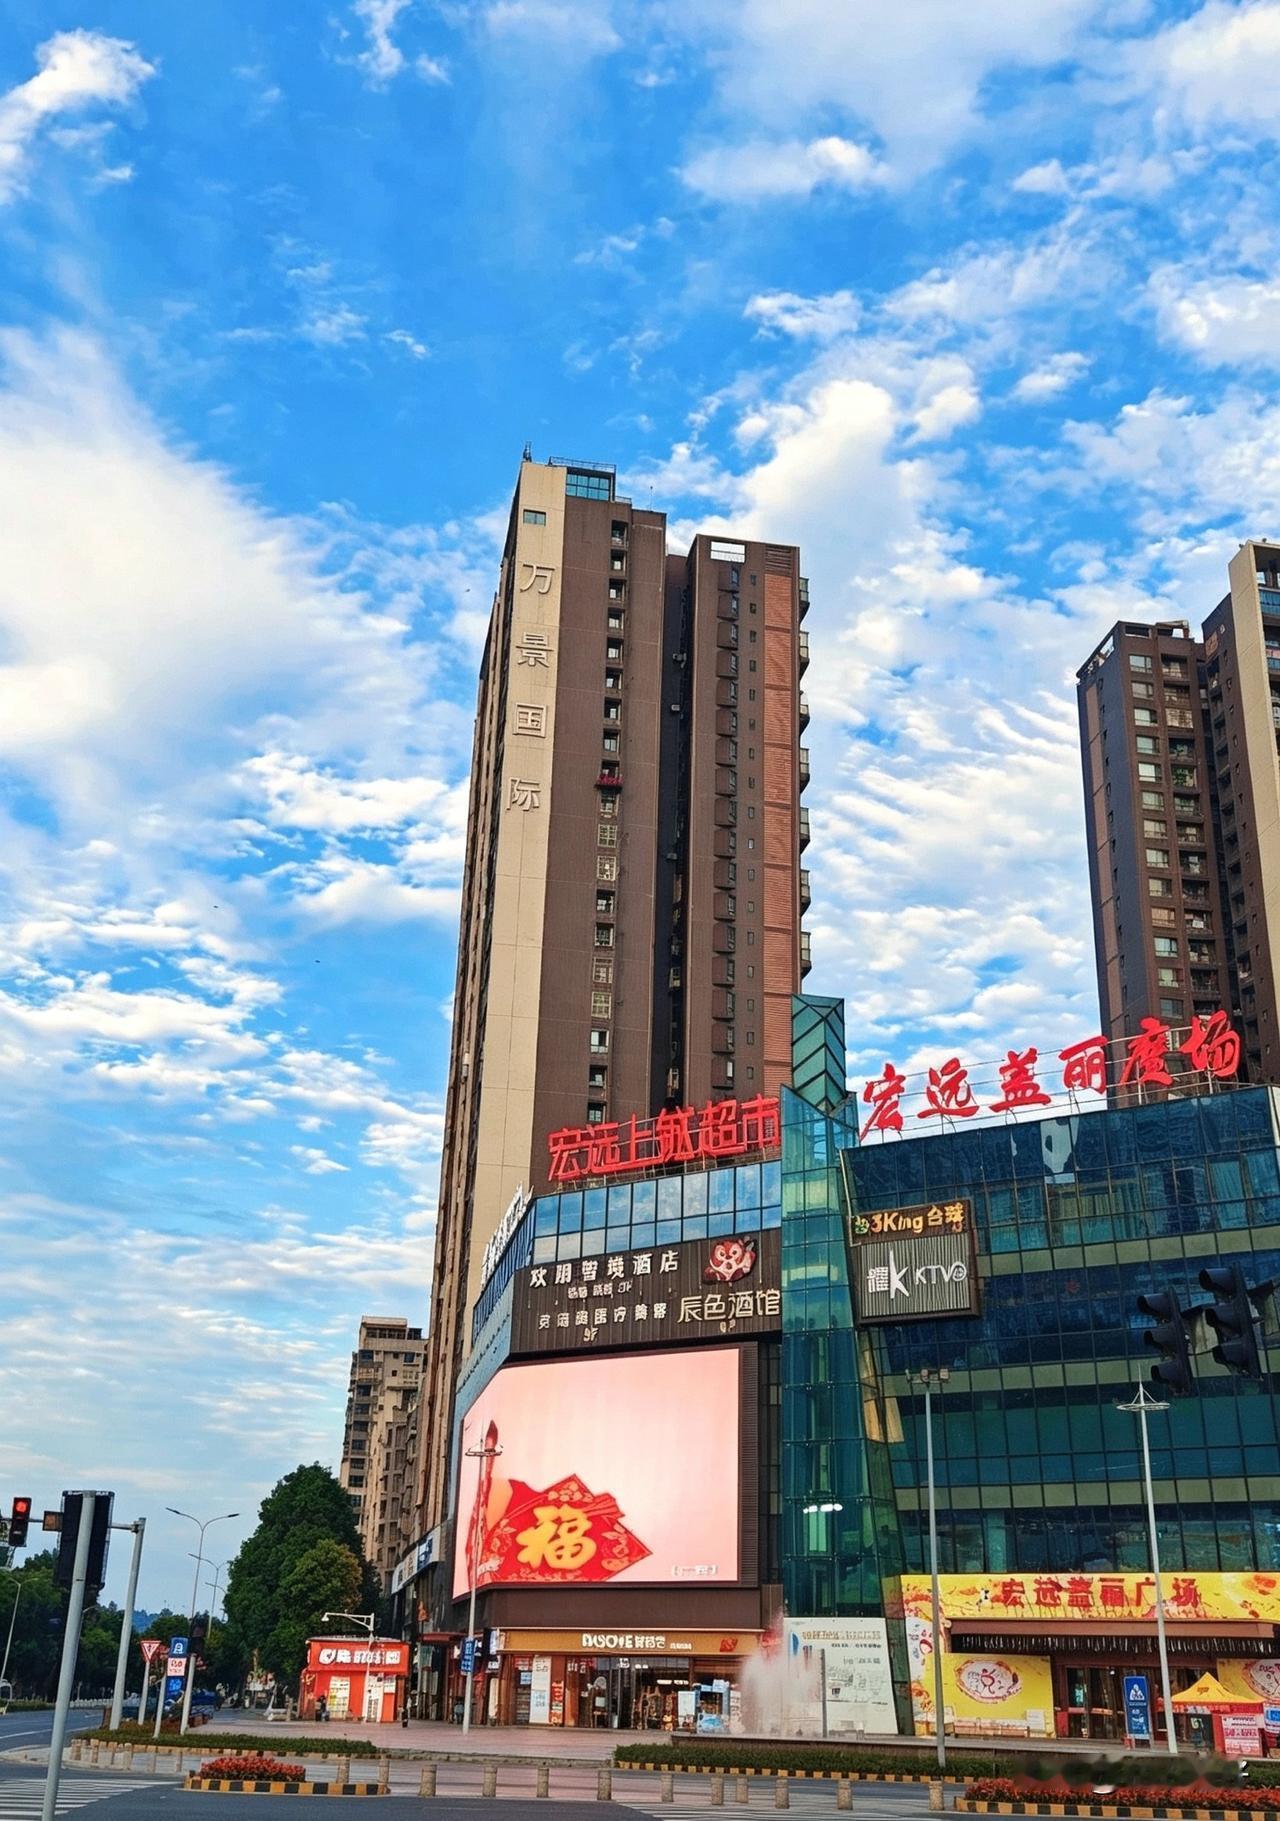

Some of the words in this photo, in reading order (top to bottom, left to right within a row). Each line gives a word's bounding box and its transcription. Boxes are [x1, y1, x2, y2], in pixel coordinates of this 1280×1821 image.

[506, 562, 556, 813] 万景国际
[677, 1288, 781, 1324] 辰色酒馆
[516, 1504, 598, 1570] 福
